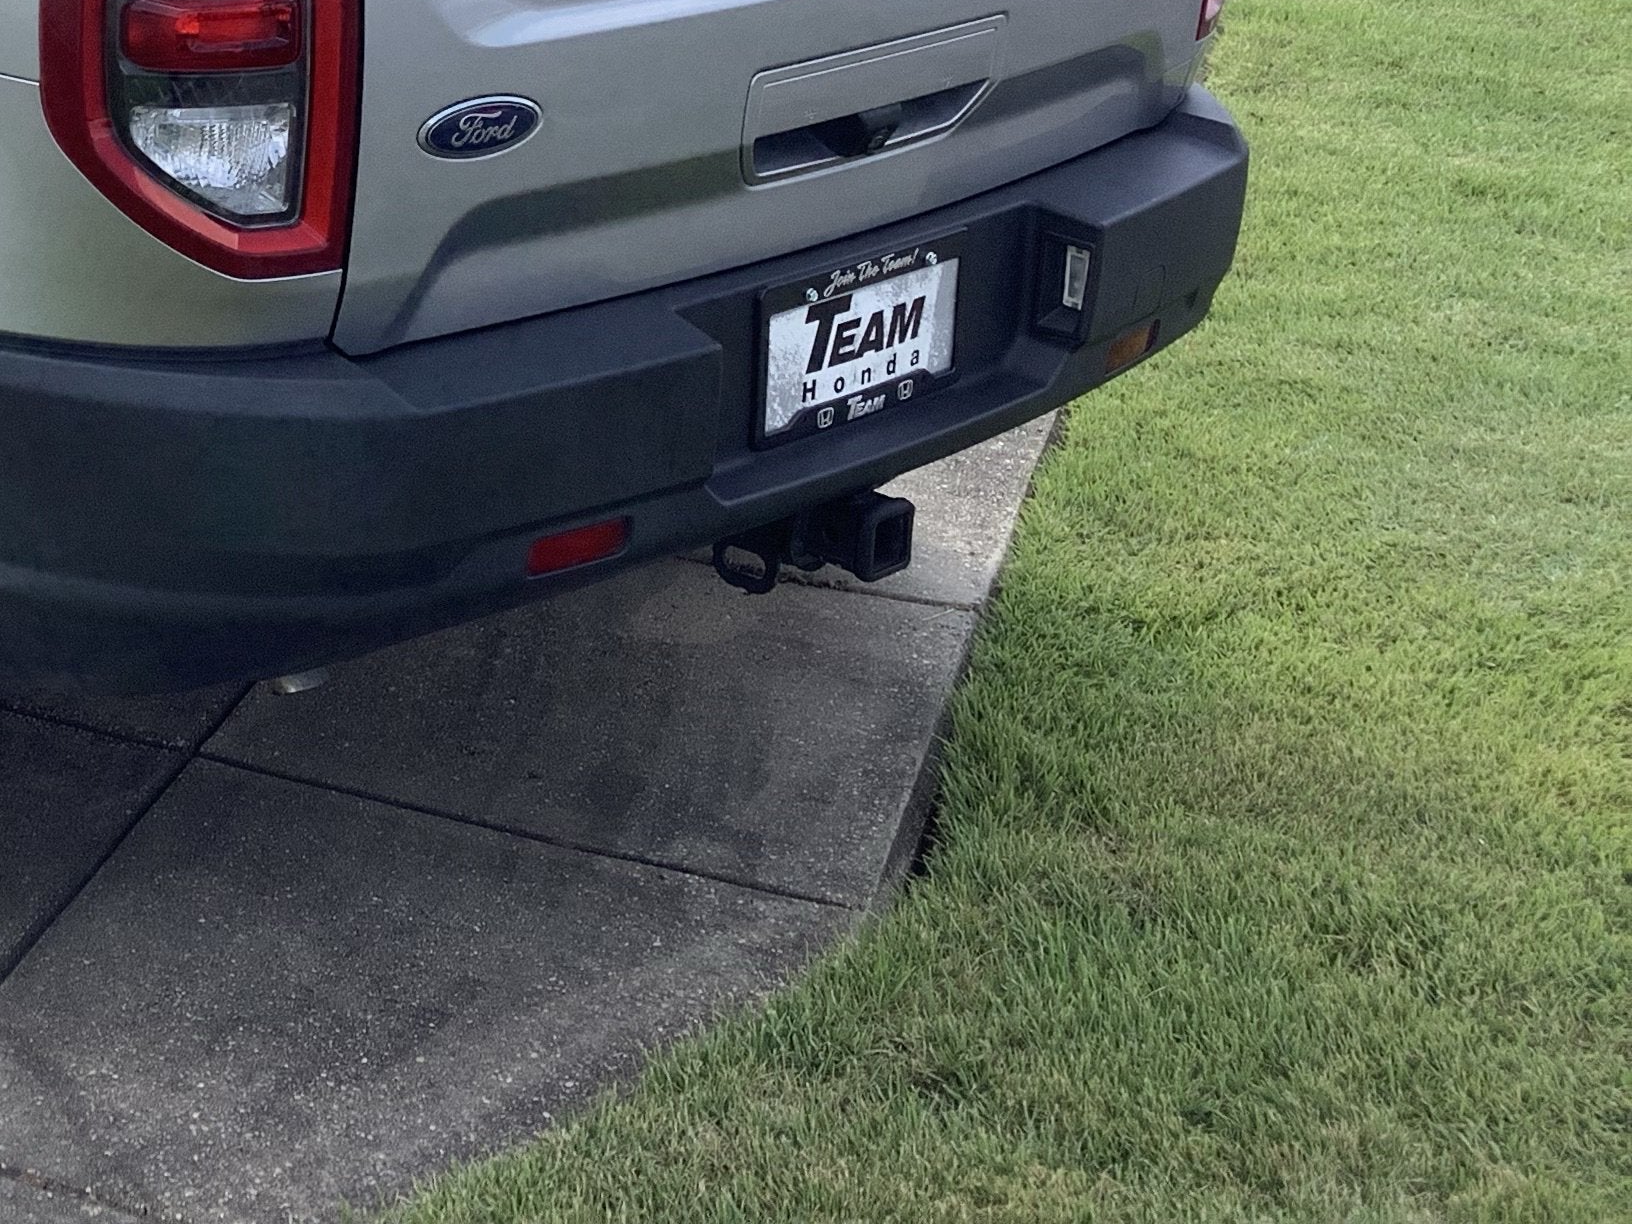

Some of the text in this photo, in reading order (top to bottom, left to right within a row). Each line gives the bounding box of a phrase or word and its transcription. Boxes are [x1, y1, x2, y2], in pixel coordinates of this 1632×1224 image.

[451, 110, 519, 148] Ford
[824, 247, 920, 297] Join The Team!
[804, 294, 927, 375] TEAM
[801, 349, 920, 404] Honda
[846, 394, 886, 421] TEAM
